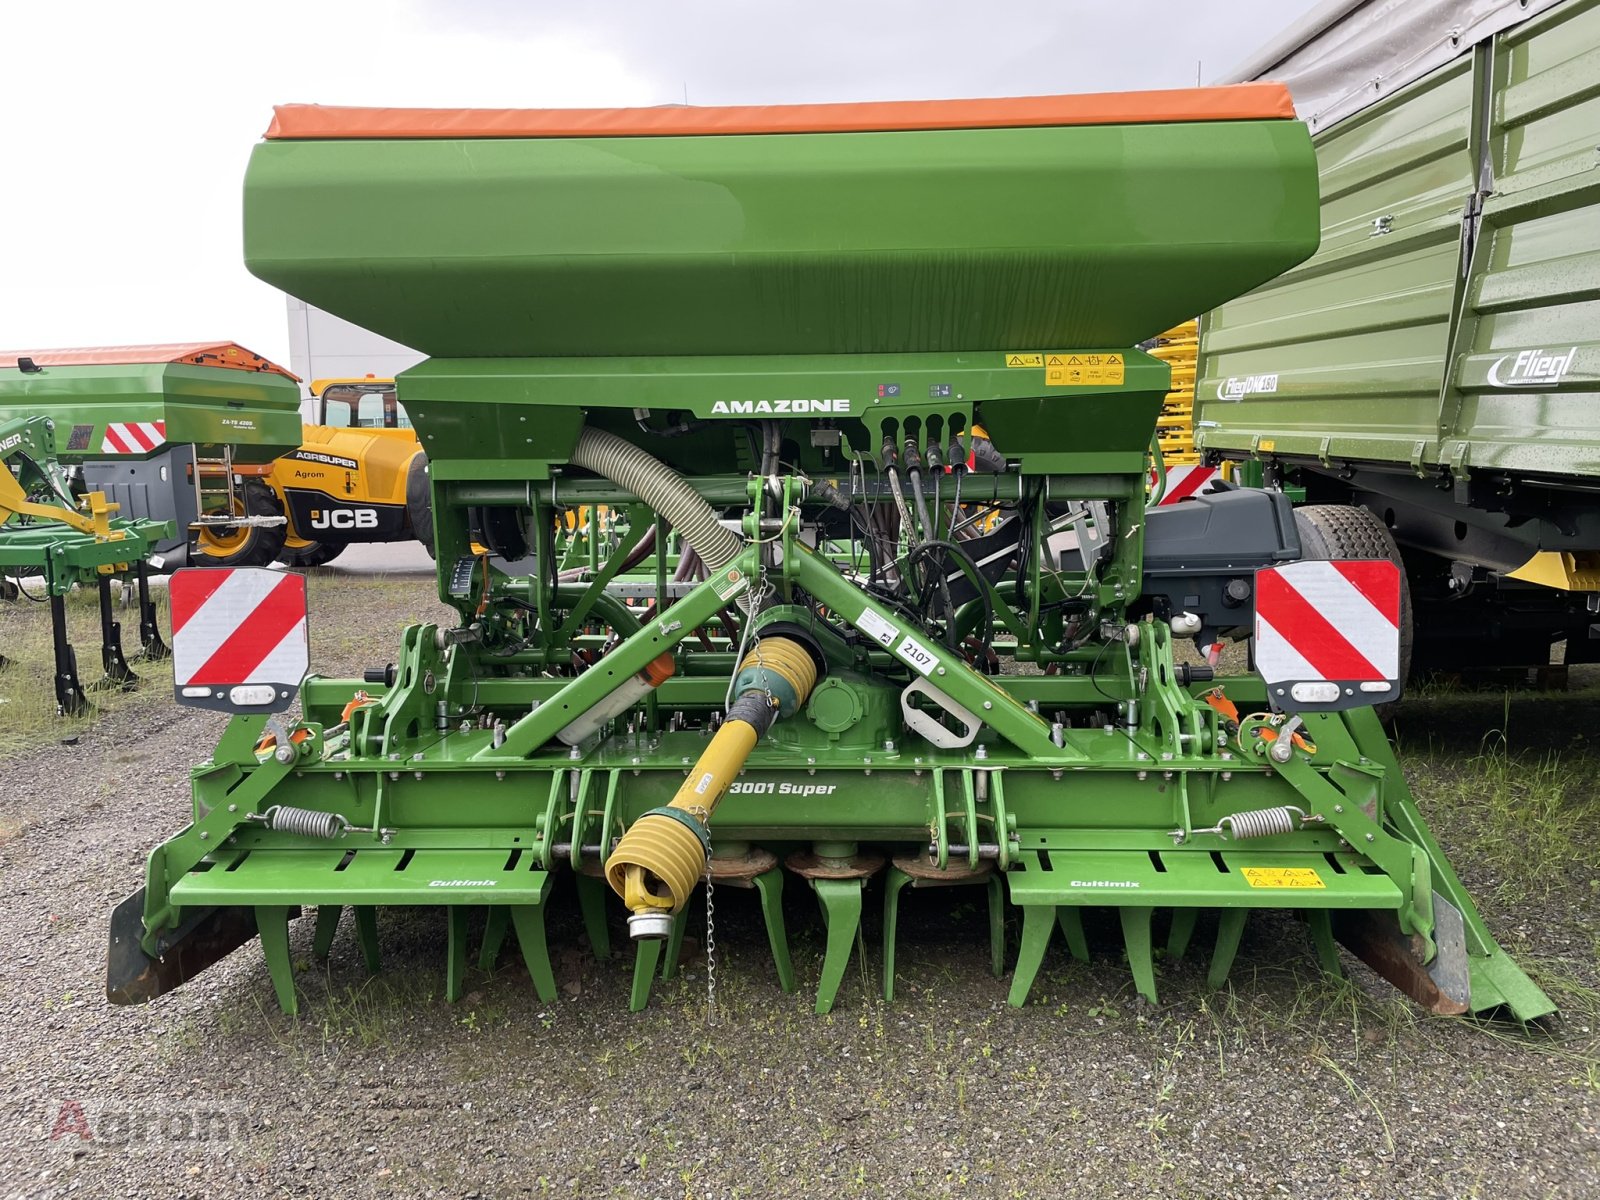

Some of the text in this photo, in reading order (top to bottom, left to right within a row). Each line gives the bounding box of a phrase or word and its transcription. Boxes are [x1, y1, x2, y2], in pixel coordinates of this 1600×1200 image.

[1509, 347, 1578, 382] Fliegl
[711, 399, 850, 414] AMAZONE
[296, 451, 357, 469] AGRISUPER
[295, 470, 325, 479] Agrom
[311, 508, 379, 529] JCB
[903, 643, 931, 665] 2107
[729, 782, 775, 794] 3001
[778, 782, 836, 797] Super
[428, 879, 499, 887] Cultimix
[1070, 880, 1140, 888] Cultimix
